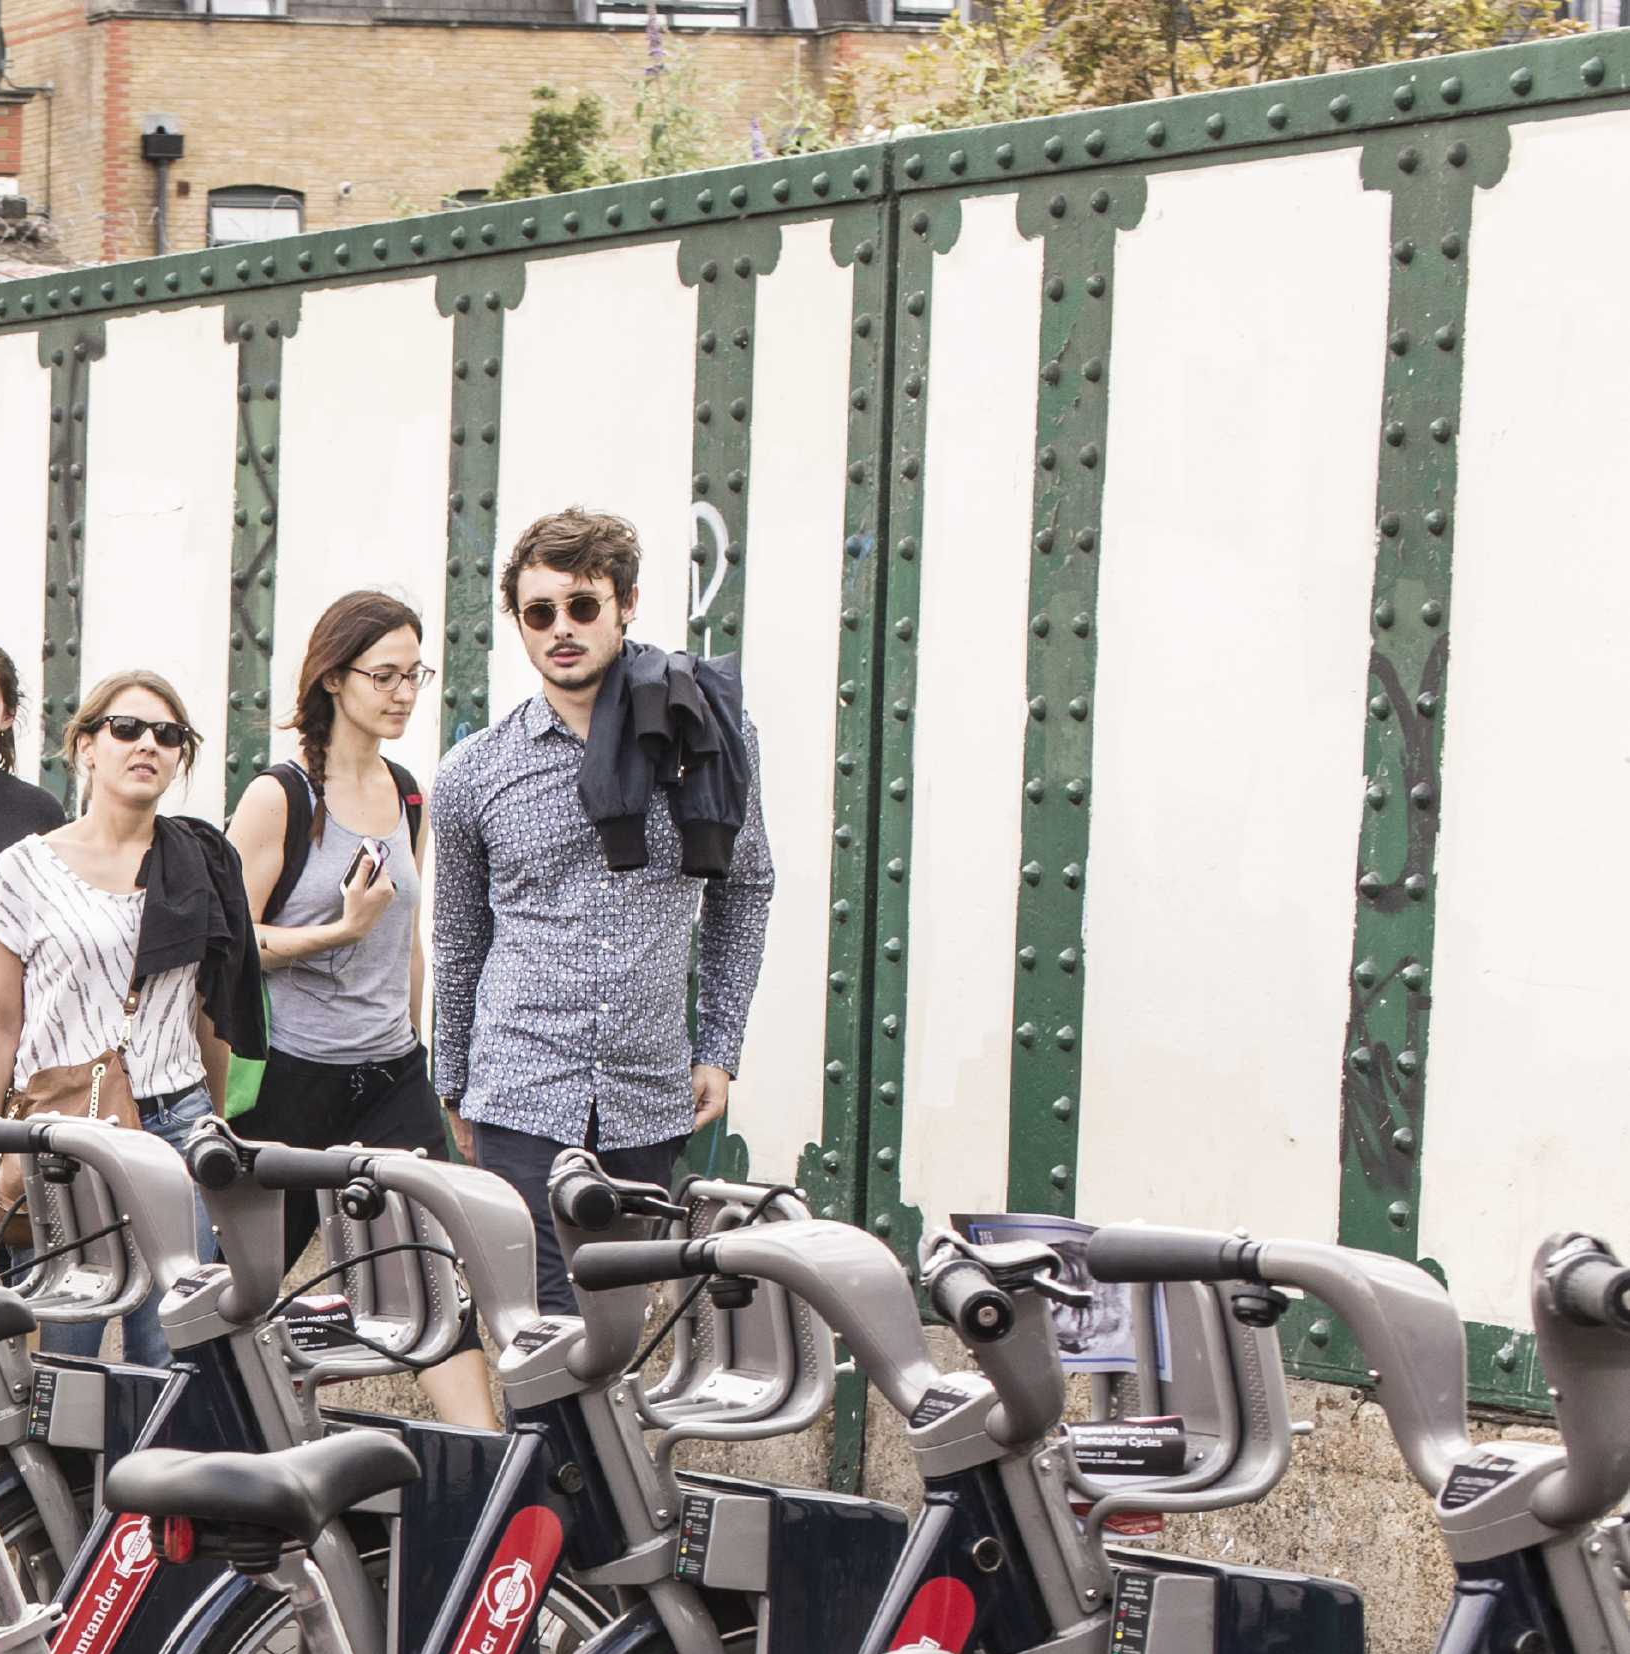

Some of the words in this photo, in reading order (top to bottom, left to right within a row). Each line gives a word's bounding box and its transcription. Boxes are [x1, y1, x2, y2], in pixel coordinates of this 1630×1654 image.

[1073, 1426, 1113, 1435] Explore
[1114, 1426, 1154, 1435] London
[1154, 1426, 1179, 1435] with
[1075, 1435, 1127, 1446] Santander
[1128, 1436, 1163, 1448] Cycles
[503, 1581, 519, 1607] CYCLES
